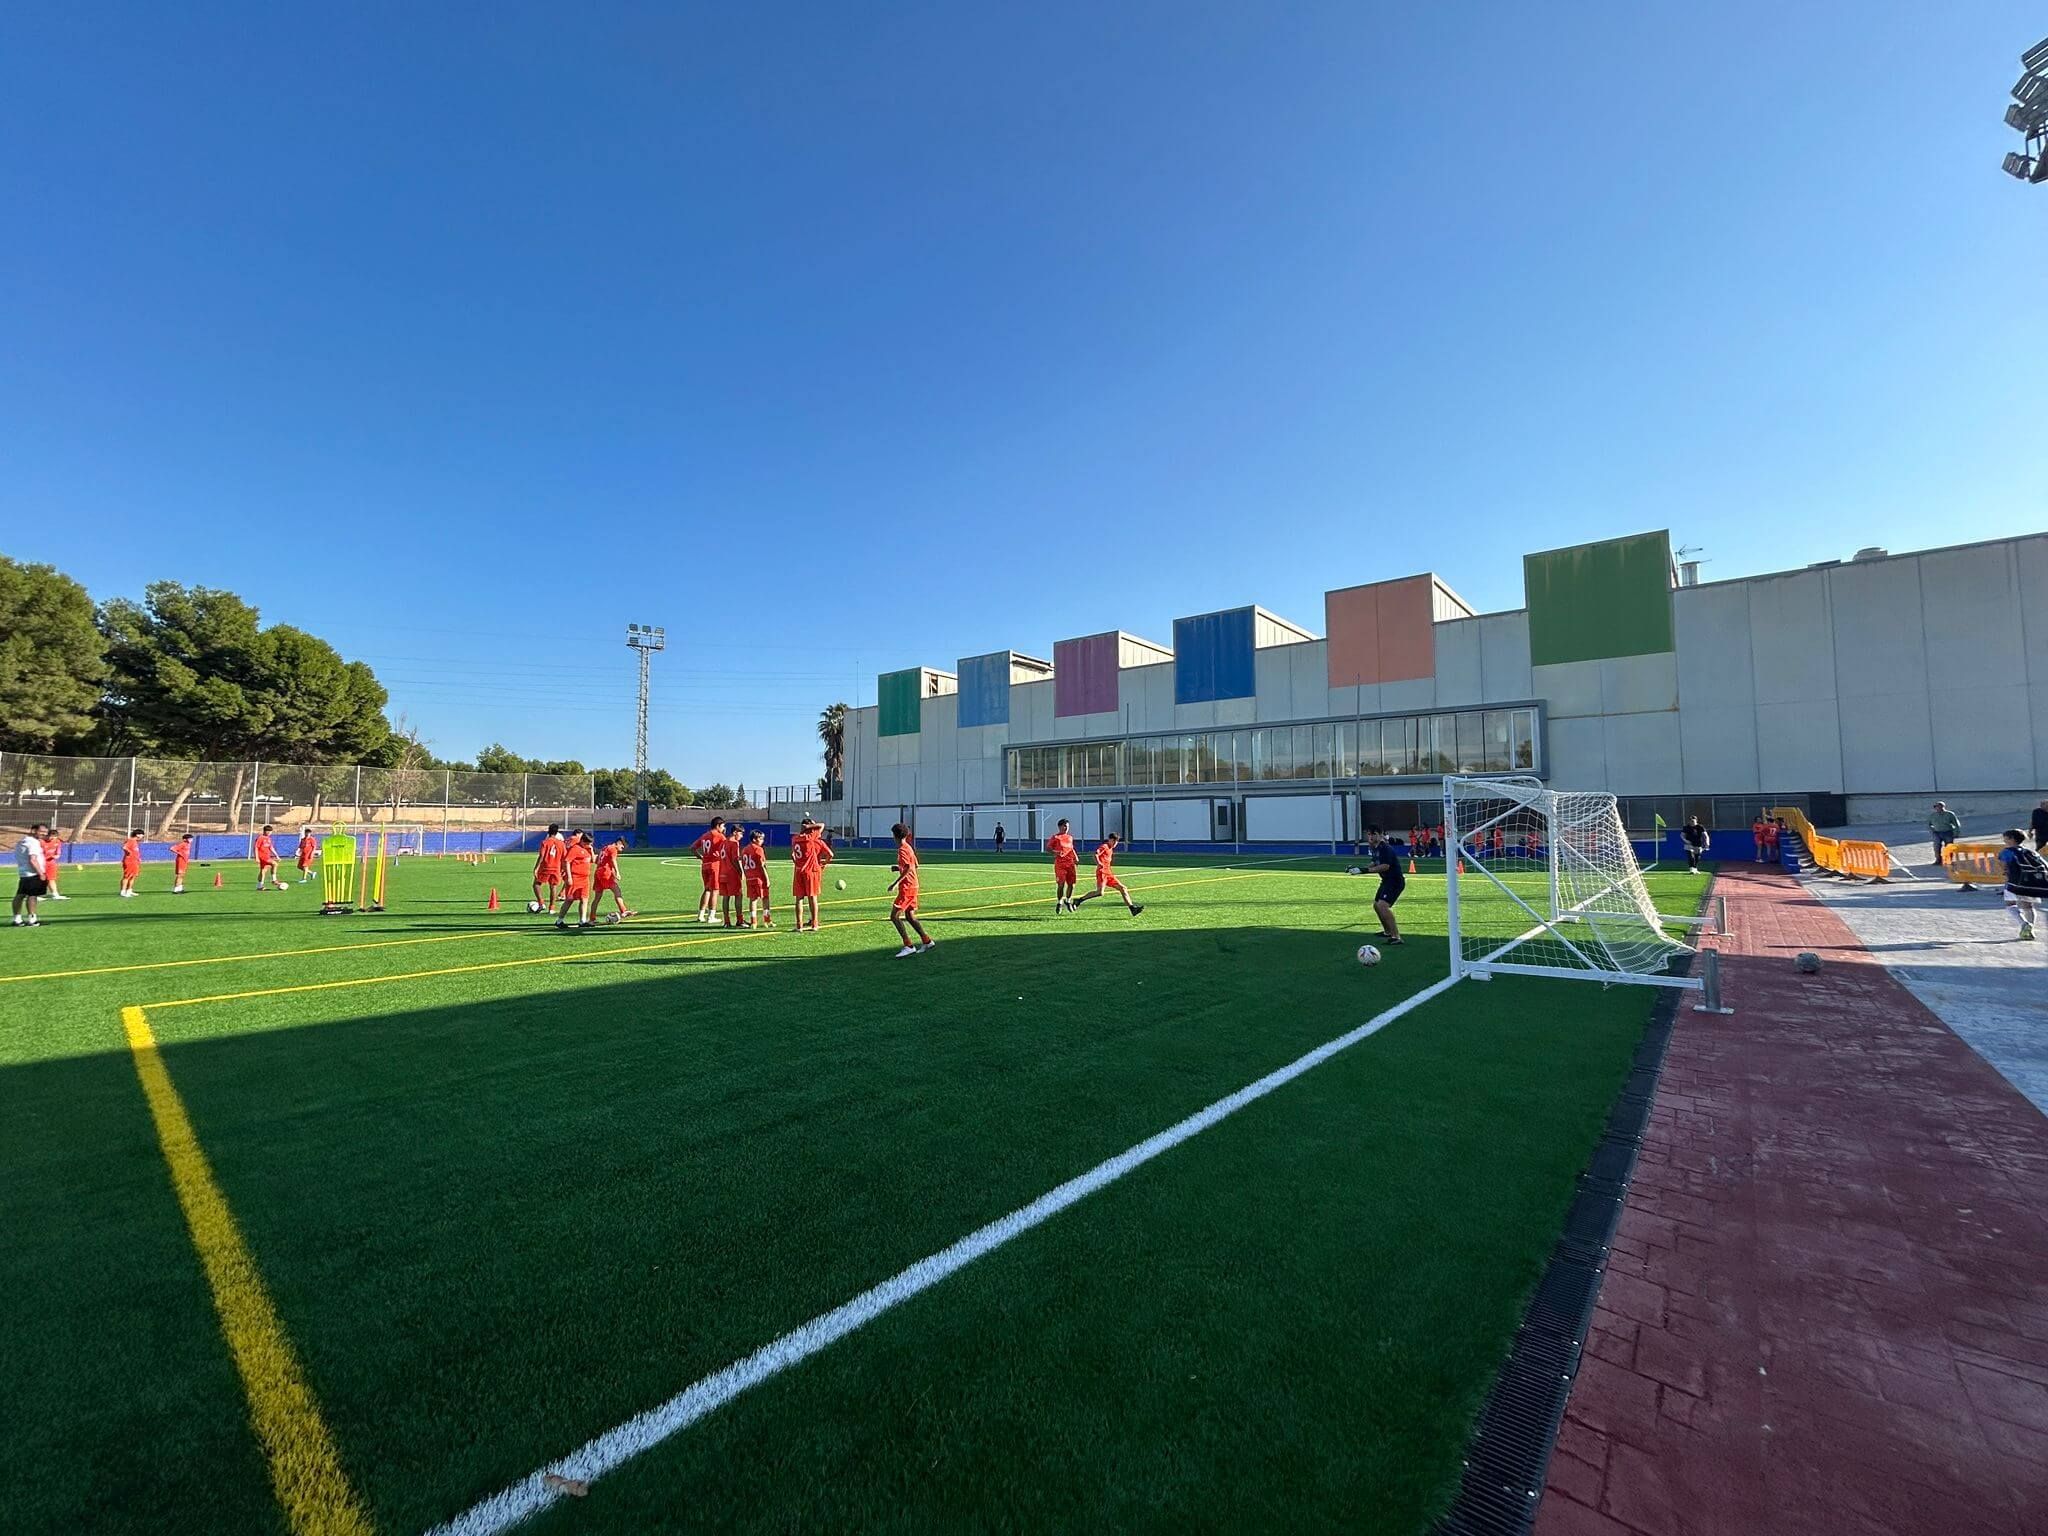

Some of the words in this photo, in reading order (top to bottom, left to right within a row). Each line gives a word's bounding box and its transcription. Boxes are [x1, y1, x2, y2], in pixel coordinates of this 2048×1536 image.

[549, 844, 557, 857] 4
[702, 839, 711, 854] 19
[743, 854, 756, 870] 26
